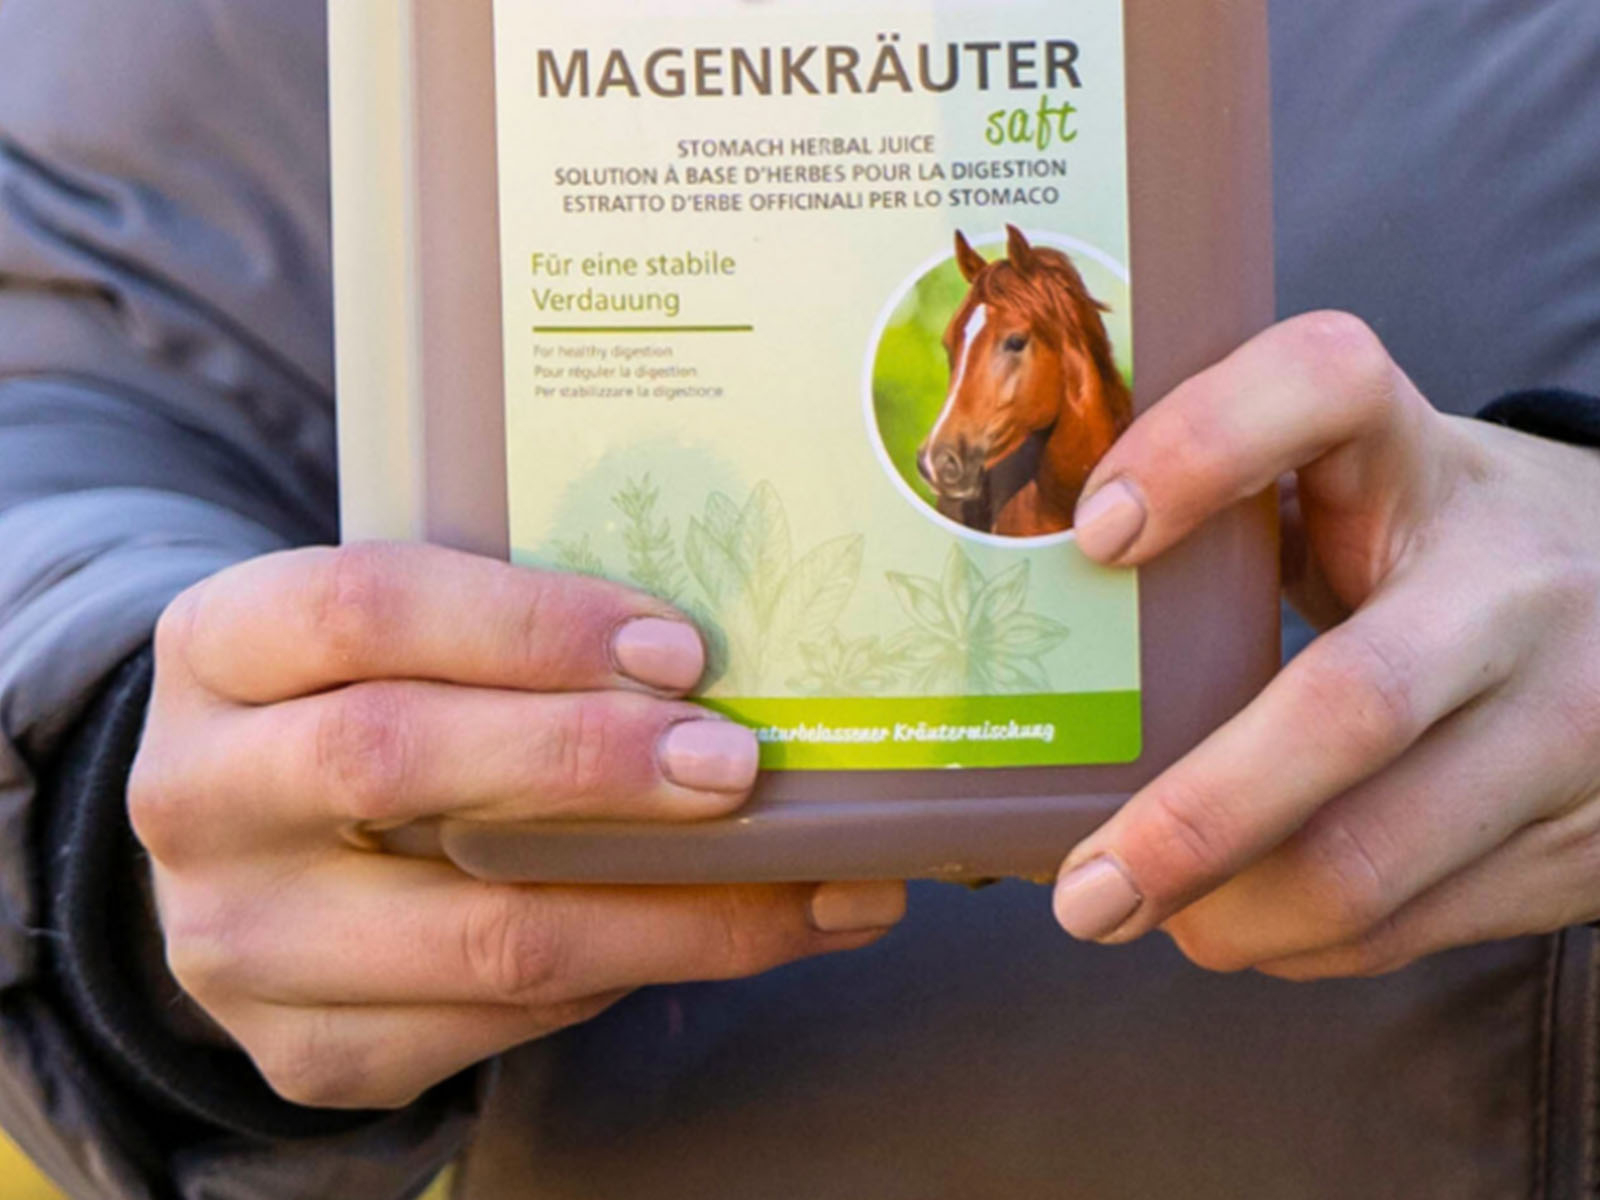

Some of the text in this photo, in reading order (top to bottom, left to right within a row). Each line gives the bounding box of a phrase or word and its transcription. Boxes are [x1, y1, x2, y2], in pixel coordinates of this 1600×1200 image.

[536, 34, 1082, 98] MAGENKRÄUTER
[985, 94, 1077, 150] saft
[677, 135, 935, 158] STOMACH HERBAL JUICE
[555, 159, 1066, 185] SOLUTION À BASE D'HERBES POUR LA DIGESTION
[563, 187, 1059, 212] ESTRATTO D'ERBE OFFICINALI PER LO STOMACO
[531, 250, 736, 276] Für eine stabile
[531, 287, 680, 317] Verdauung
[533, 344, 673, 360] For healthy digestion
[534, 365, 564, 378] Pour
[635, 364, 697, 380] digestion
[534, 385, 555, 398] Per
[637, 384, 649, 398] la
[893, 721, 1055, 743] Kräutermischung
